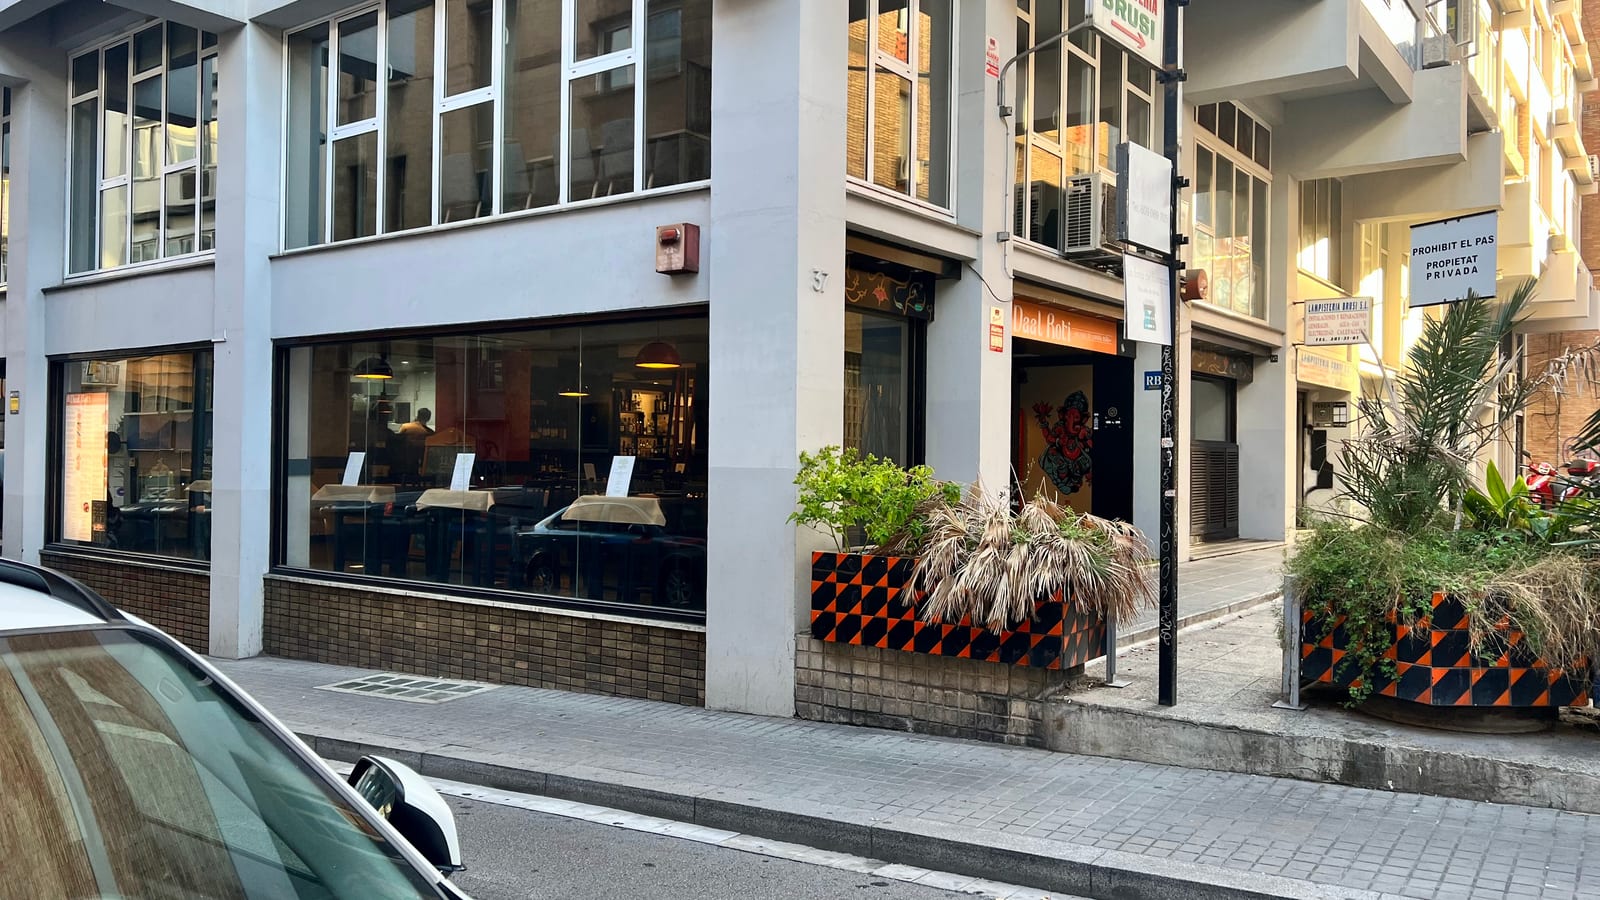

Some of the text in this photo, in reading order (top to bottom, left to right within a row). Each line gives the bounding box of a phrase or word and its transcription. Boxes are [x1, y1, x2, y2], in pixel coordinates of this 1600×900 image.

[1103, 0, 1155, 41] BRUSI
[1412, 235, 1495, 256] PROHIBIT EL PAS
[1426, 254, 1478, 270] PROPIETAT
[812, 269, 829, 294] 37
[1426, 266, 1478, 280] PRIVADA
[1308, 303, 1340, 313] LAMPISTERIA
[1013, 304, 1043, 337] Daal
[1046, 312, 1071, 343] Roti
[1146, 375, 1162, 386] RB
